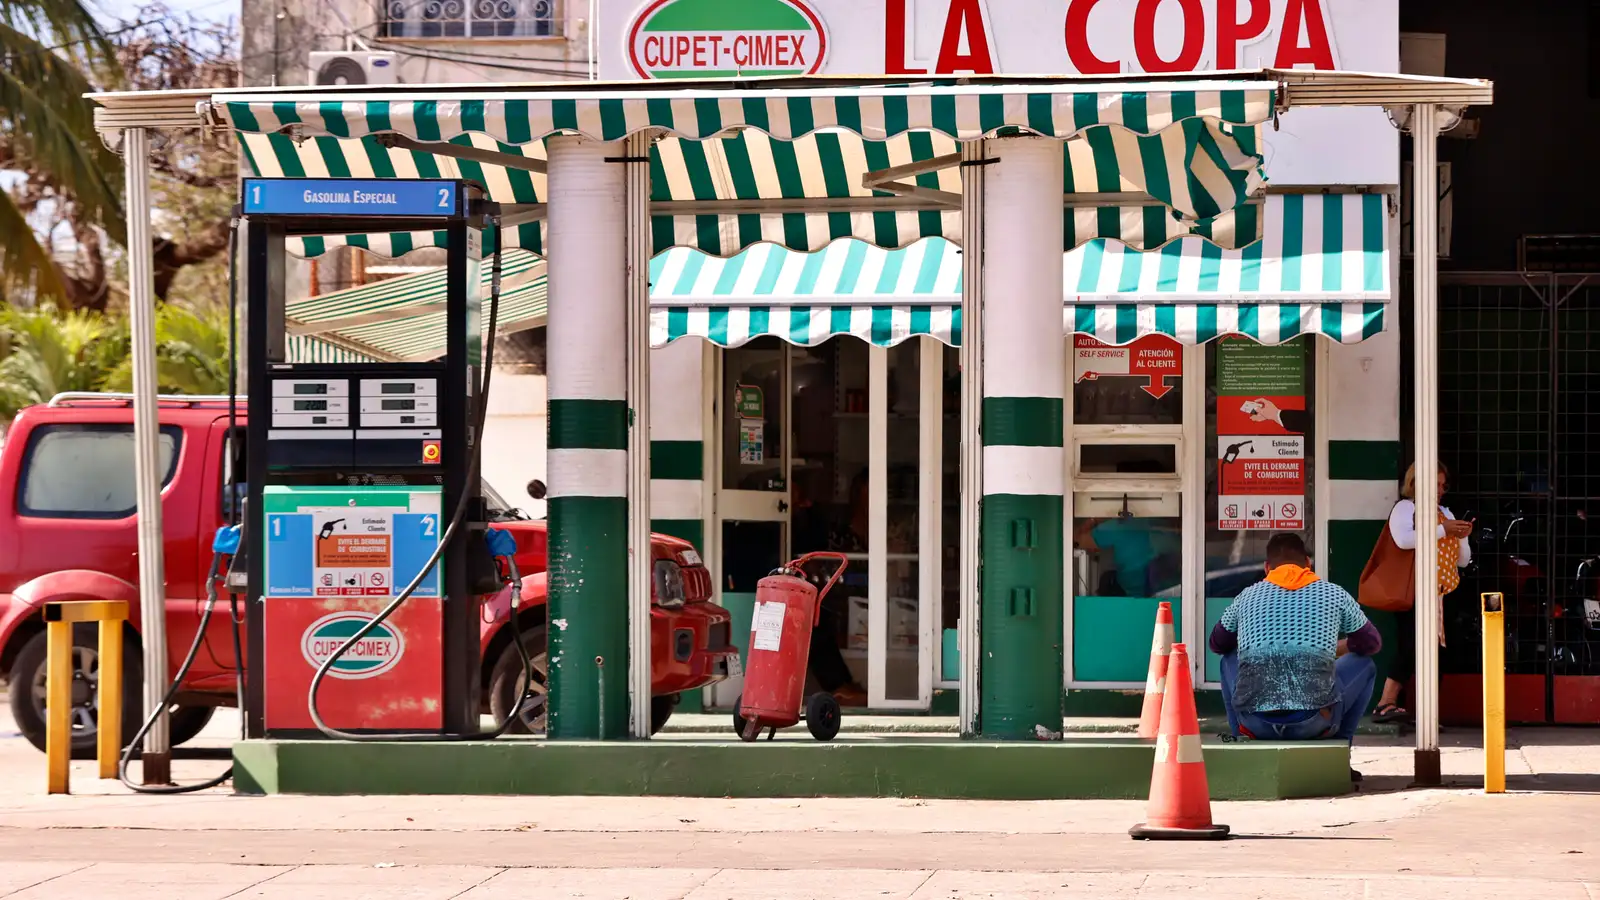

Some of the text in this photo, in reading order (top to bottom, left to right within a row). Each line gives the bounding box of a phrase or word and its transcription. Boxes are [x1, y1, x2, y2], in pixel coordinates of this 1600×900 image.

[885, 0, 1336, 74] LA COPA
[644, 35, 806, 67] CUPET-CIMEX
[252, 186, 261, 204] 1
[438, 188, 449, 207] 2
[1138, 348, 1174, 358] ATENCIÓN
[1147, 360, 1176, 368] CLIENTE
[272, 518, 281, 536] 1
[424, 516, 435, 536] 2
[313, 640, 392, 656] CUP-CIMEX
